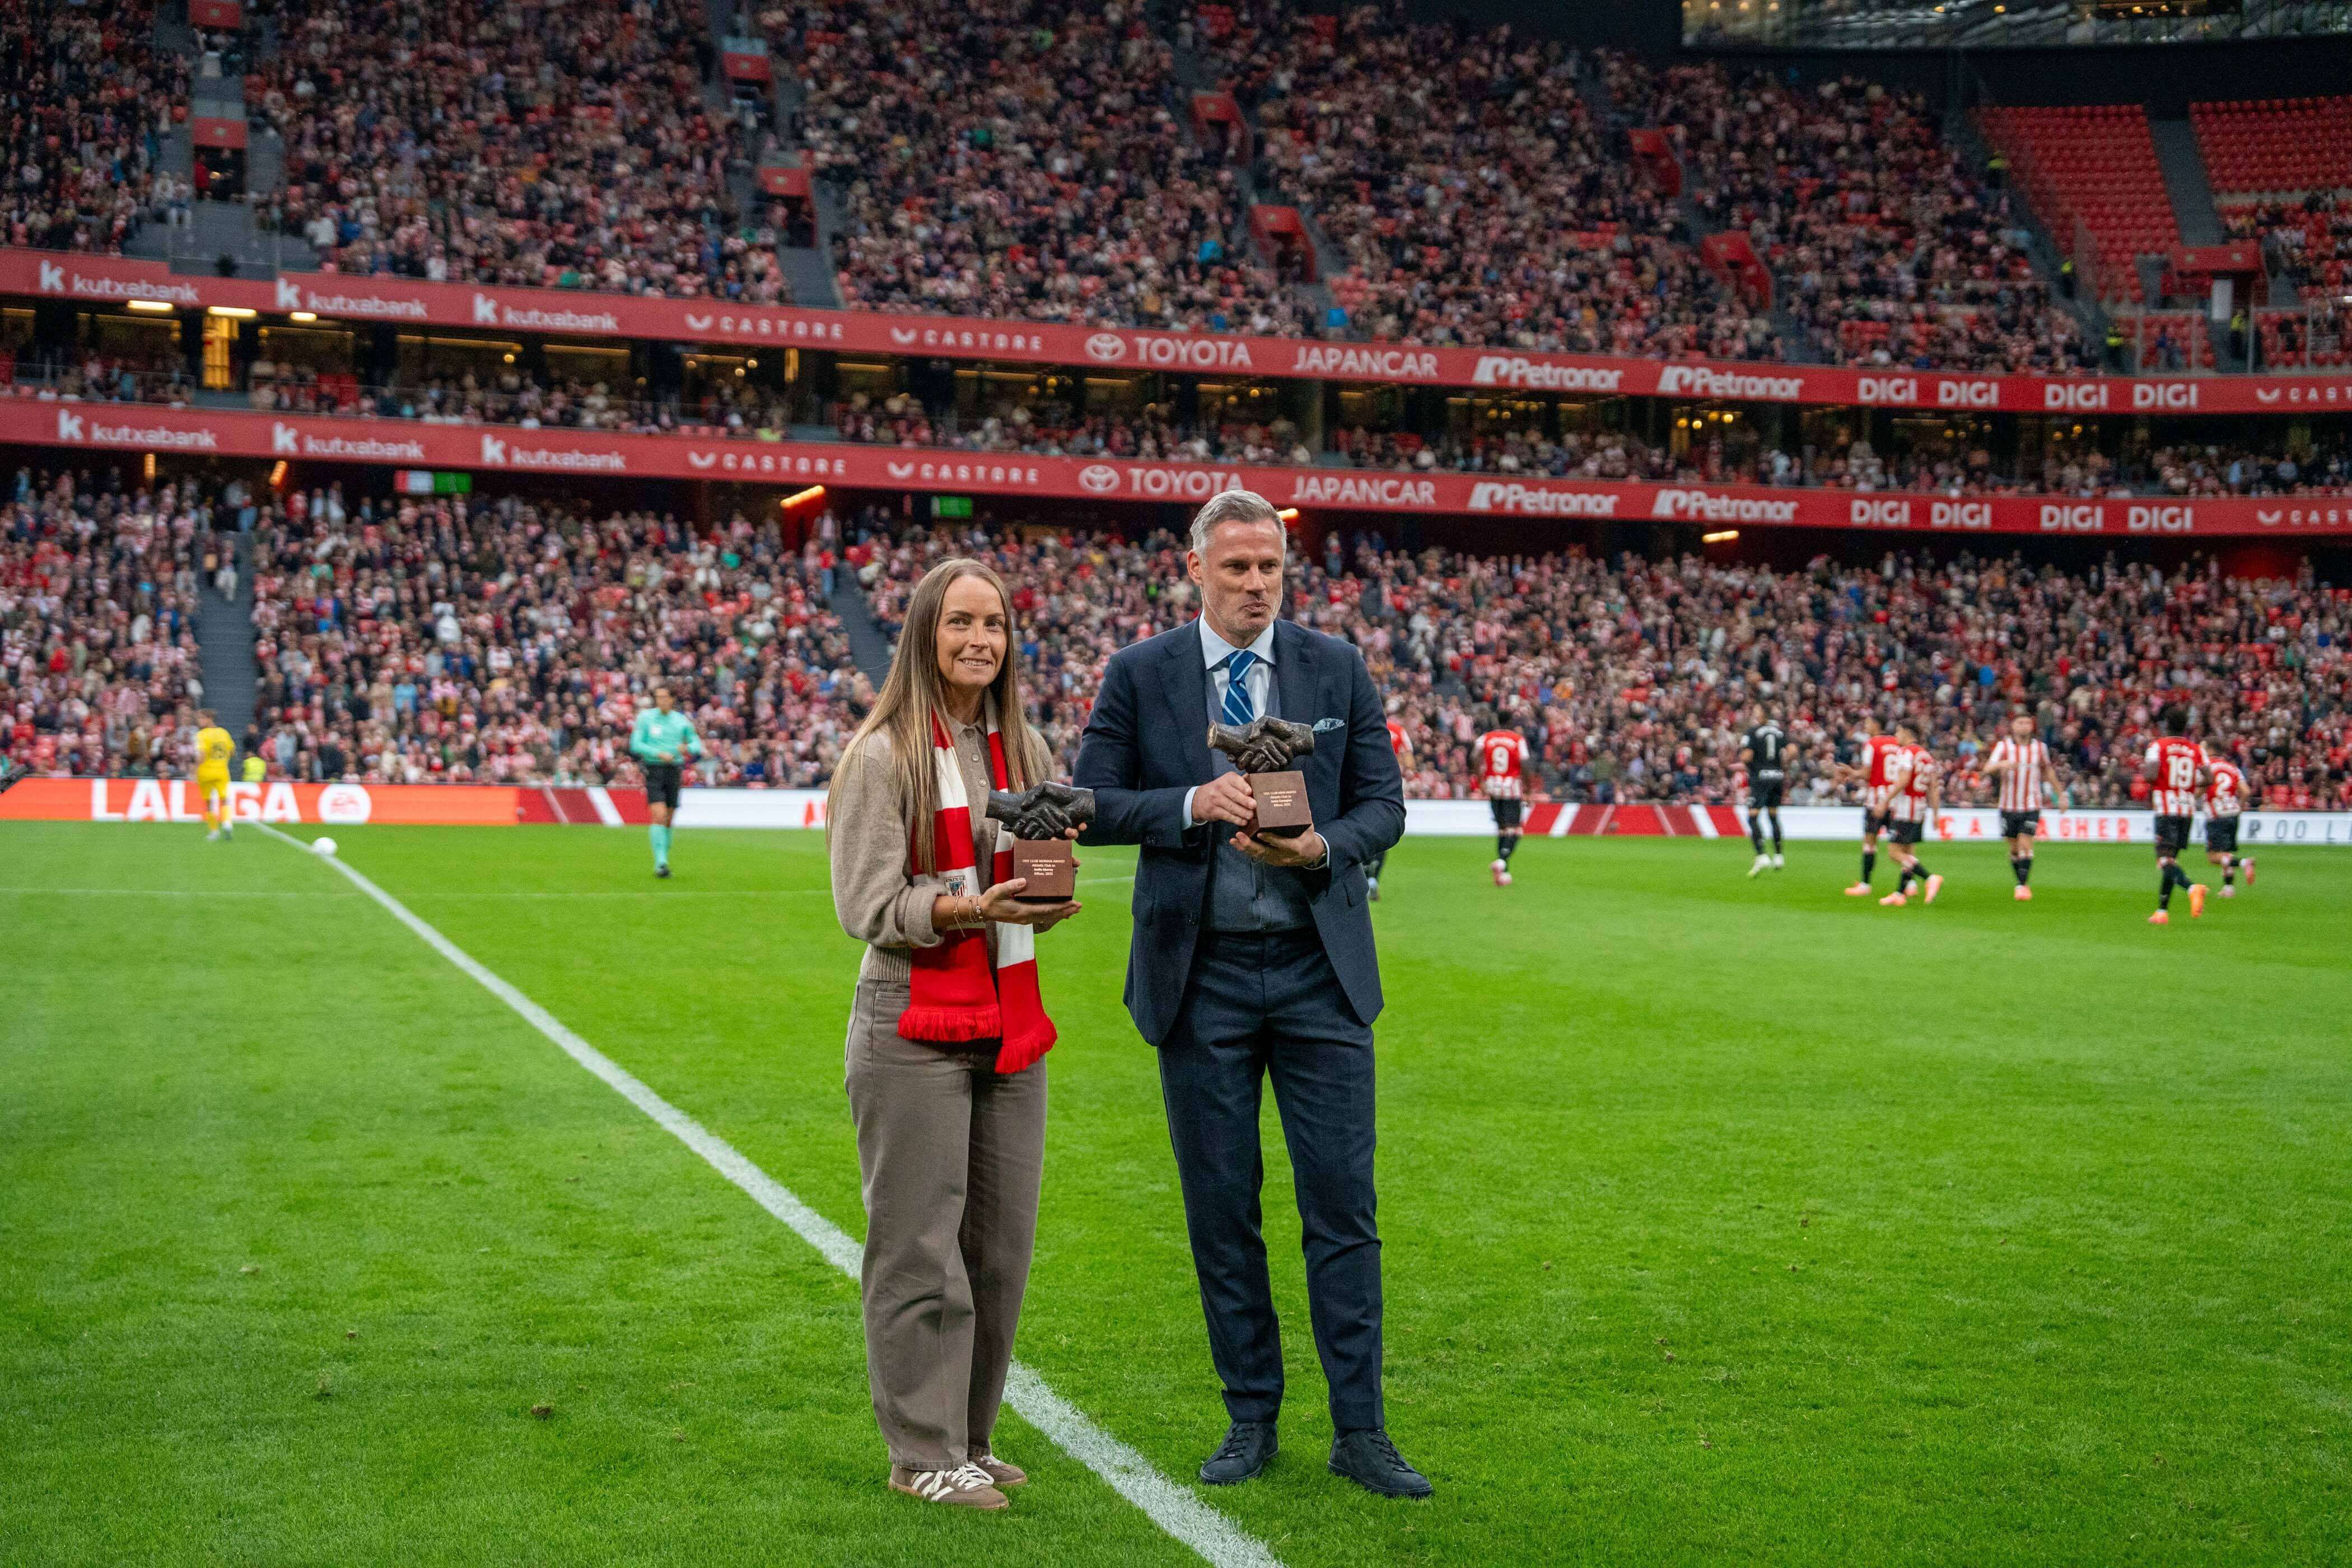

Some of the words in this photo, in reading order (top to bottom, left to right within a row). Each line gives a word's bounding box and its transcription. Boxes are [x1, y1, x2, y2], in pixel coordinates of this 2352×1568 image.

[73, 274, 199, 303] kutxabank
[308, 292, 427, 318] kutxabank
[503, 306, 618, 330] kutxabank
[720, 316, 842, 340] CASTORE
[925, 329, 1041, 351] CASTORE
[1134, 337, 1252, 366] TOYOTA
[1293, 346, 1438, 377] JAPANCAR
[1510, 357, 1623, 390] Petronor
[1691, 367, 1804, 399] Petronor
[1858, 377, 1917, 403] DIGI
[1938, 381, 1999, 406] DIGI
[2045, 384, 2108, 408] DIGI
[2133, 384, 2198, 408] DIGI
[91, 423, 217, 447] kutxabank
[305, 435, 424, 459] kutxabank
[511, 446, 626, 470] kutxabank
[723, 453, 845, 475] CASTORE
[921, 463, 1038, 484] CASTORE
[1128, 468, 1245, 496] TOYOTA
[1291, 475, 1435, 505] JAPANCAR
[1505, 483, 1619, 515] Petronor
[1686, 490, 1798, 522] Petronor
[1851, 500, 1910, 525] DIGI
[1931, 502, 1991, 528] DIGI
[2041, 505, 2103, 530] DIGI
[2128, 506, 2193, 531] DIGI
[1765, 734, 1775, 760] 1
[1492, 746, 1509, 774] 9
[2167, 755, 2194, 790] 19
[2216, 772, 2232, 797] 2
